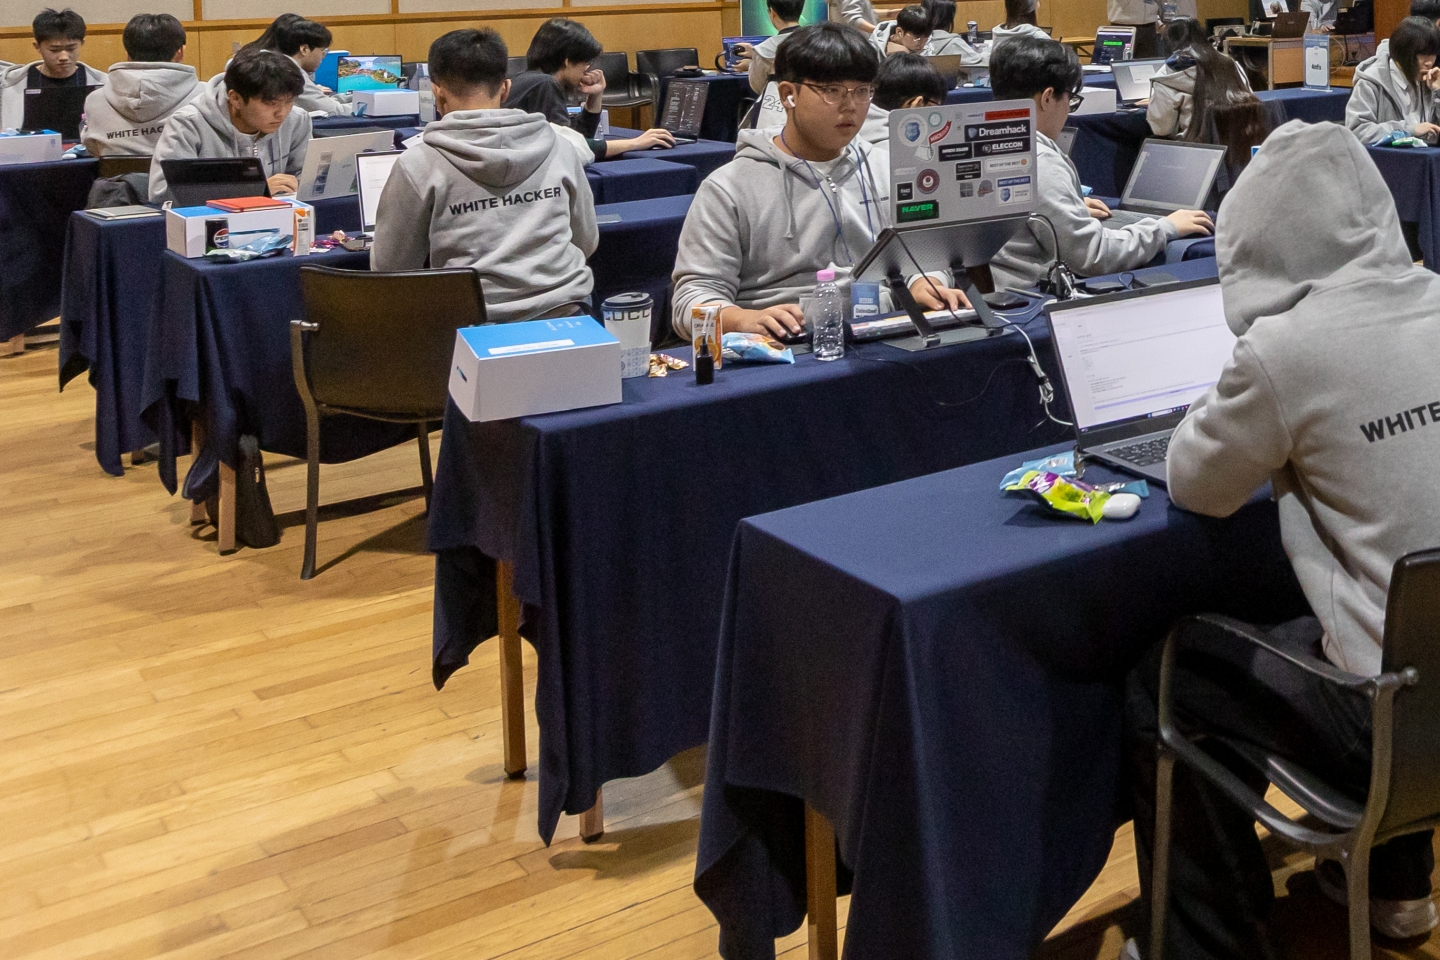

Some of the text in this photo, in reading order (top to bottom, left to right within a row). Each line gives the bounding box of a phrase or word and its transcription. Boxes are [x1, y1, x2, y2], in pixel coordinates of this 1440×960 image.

[107, 125, 164, 139] WHITE HAC
[979, 124, 1027, 136] Dreamhack
[992, 141, 1023, 150] ELECCON
[449, 187, 561, 216] WHITE HACKER
[902, 203, 934, 213] NAVER
